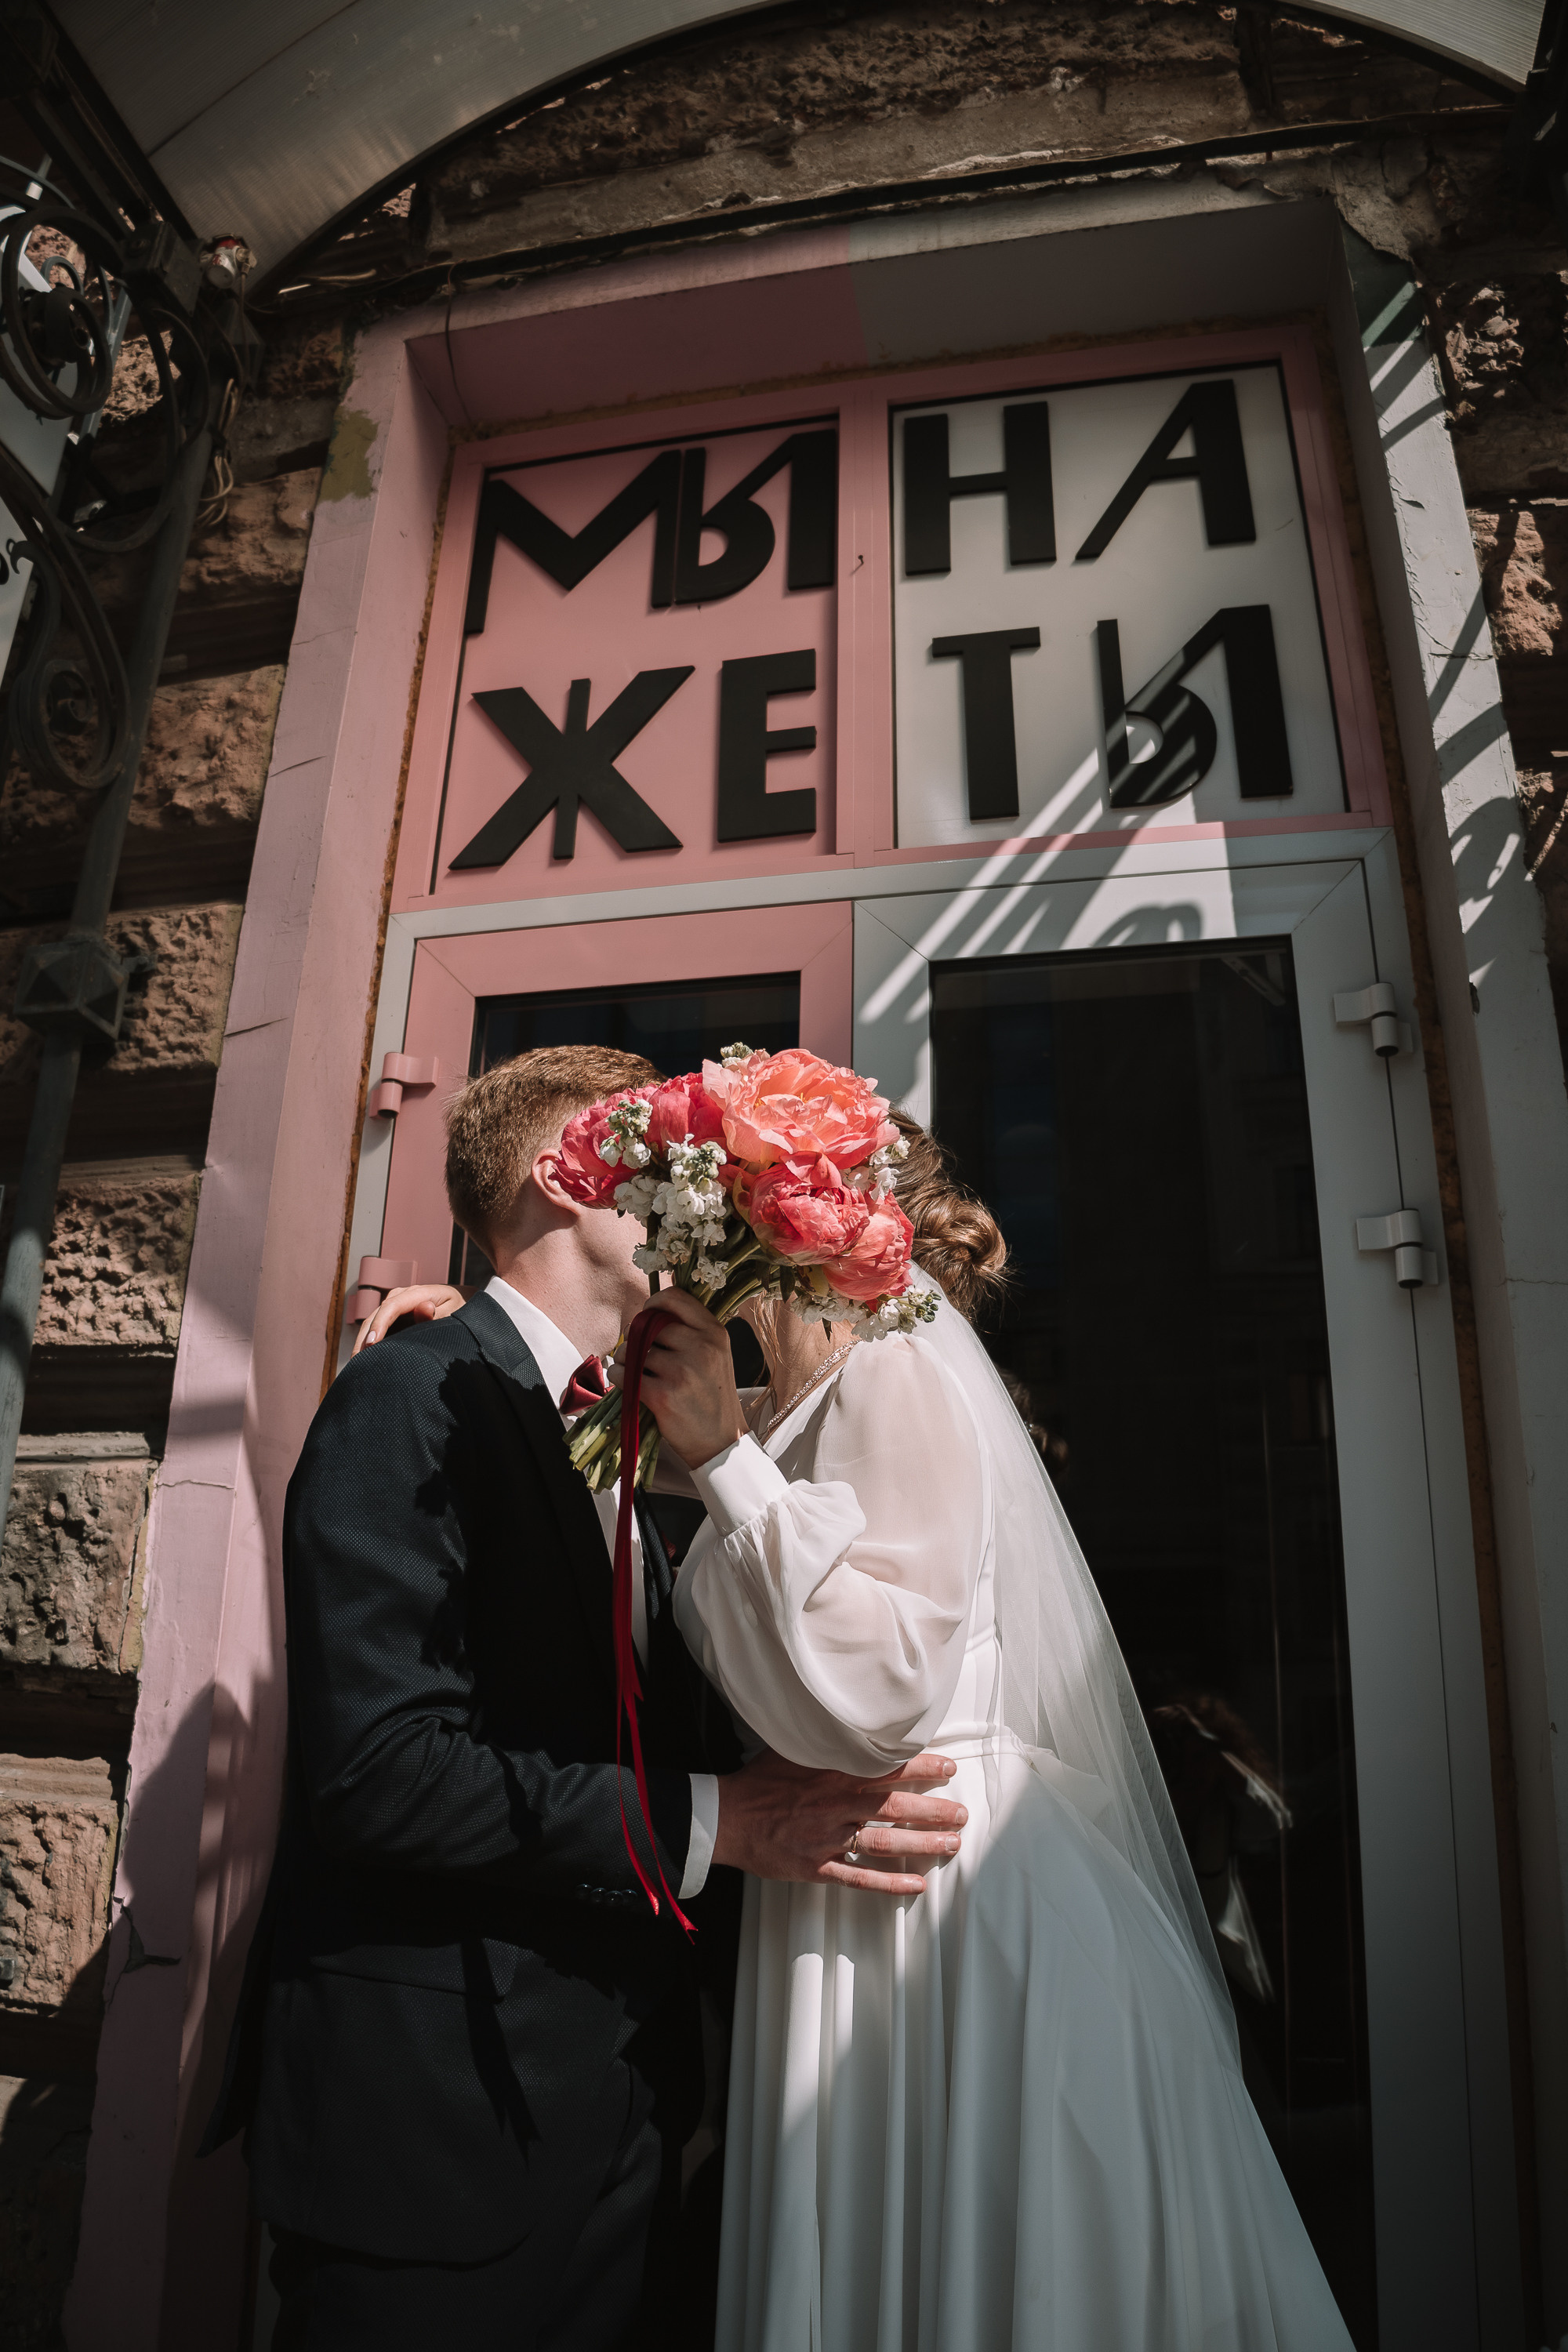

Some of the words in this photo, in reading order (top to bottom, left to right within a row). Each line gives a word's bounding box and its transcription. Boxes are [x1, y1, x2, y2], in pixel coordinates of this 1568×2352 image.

[464, 429, 837, 634] МЫ
[904, 379, 1256, 575] НА
[448, 648, 816, 870] ЖЕ
[932, 604, 1293, 821] ТЫ
